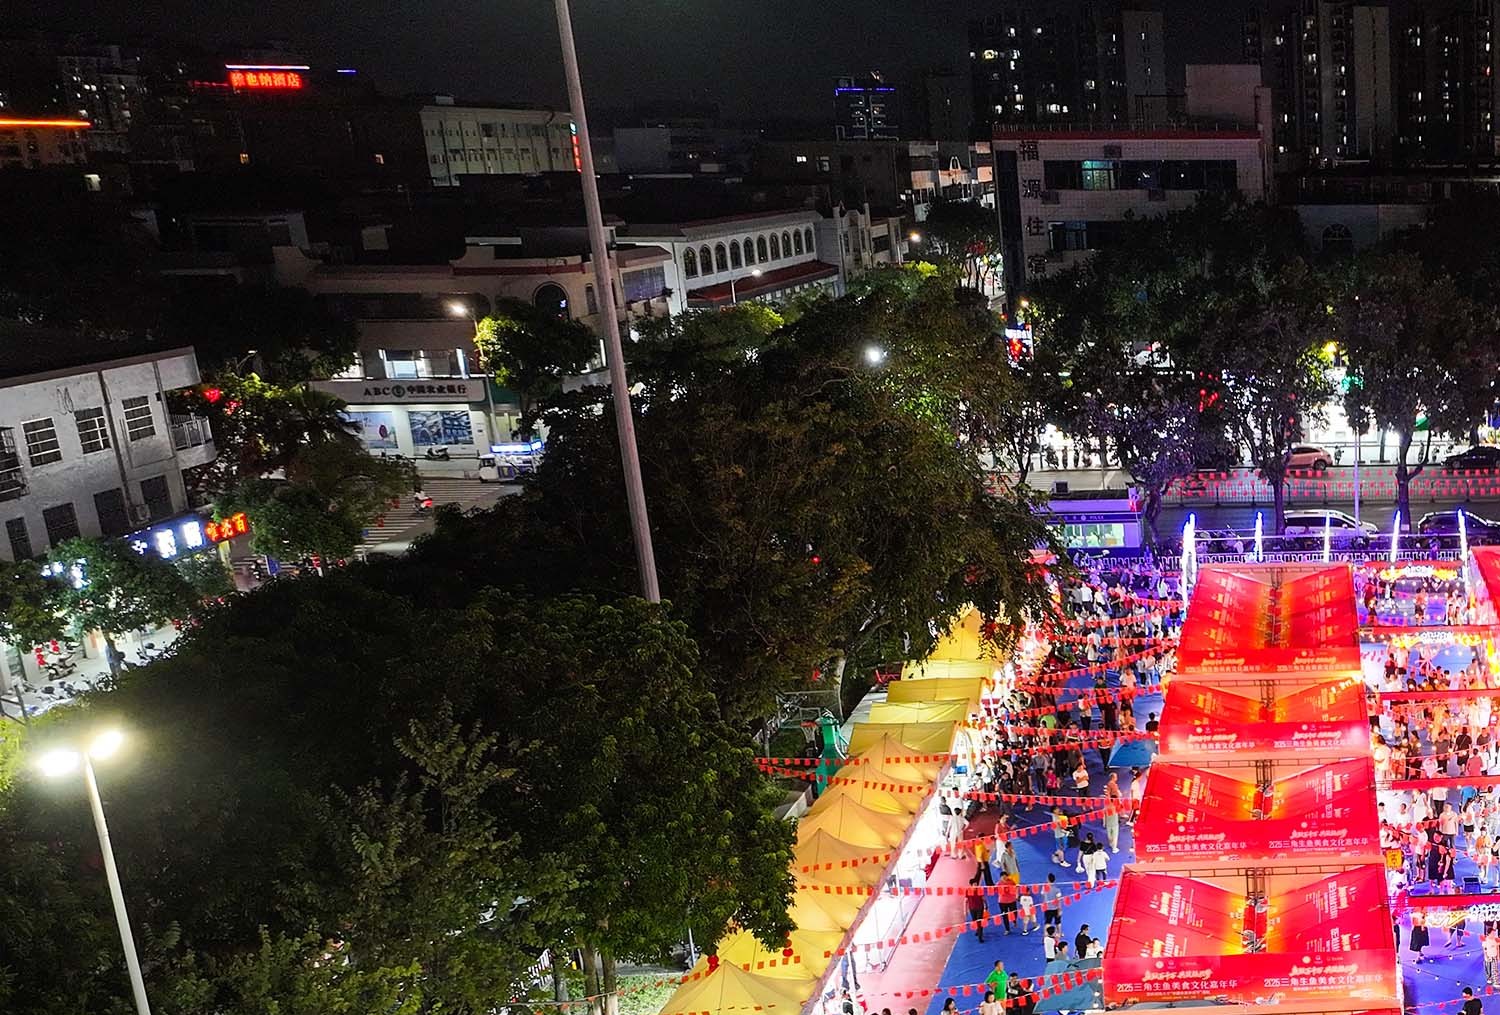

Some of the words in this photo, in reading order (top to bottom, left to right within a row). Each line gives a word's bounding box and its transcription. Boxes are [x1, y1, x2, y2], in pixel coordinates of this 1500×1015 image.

[1018, 140, 1048, 274] 福源住宿
[363, 387, 391, 396] ABC
[407, 385, 468, 394] 中国农业银行
